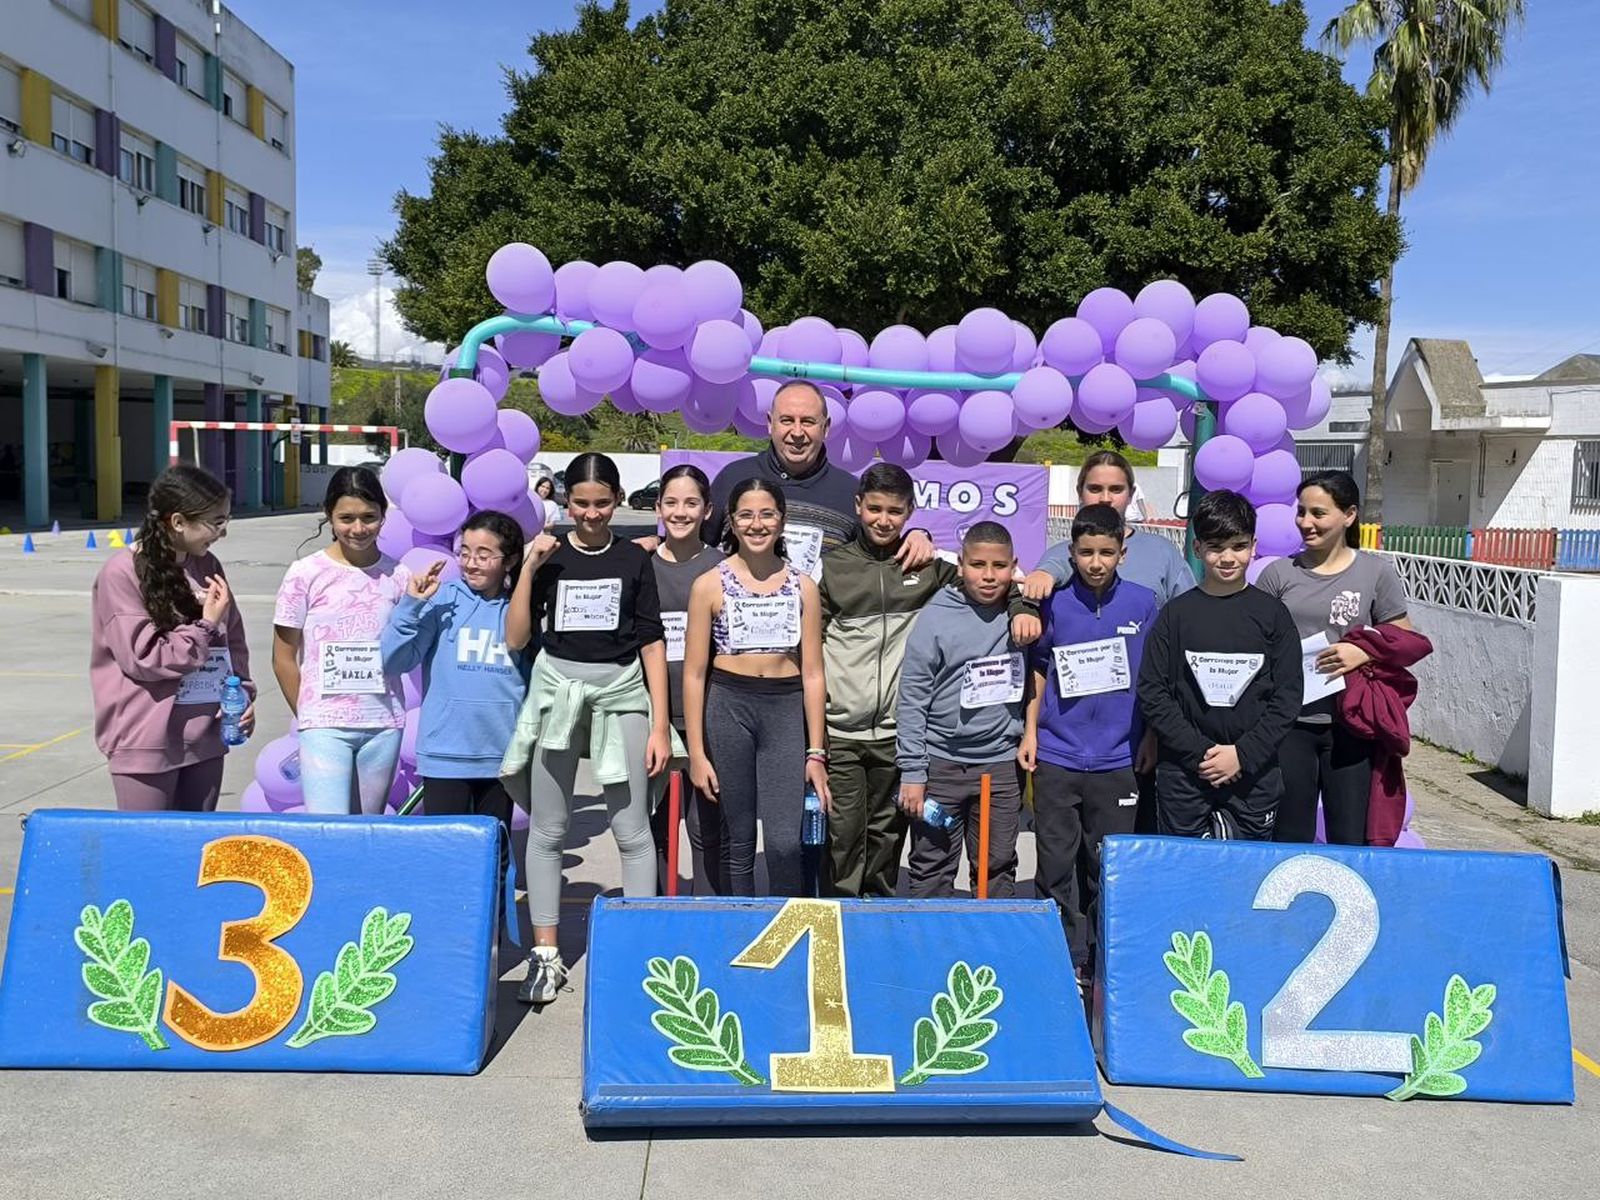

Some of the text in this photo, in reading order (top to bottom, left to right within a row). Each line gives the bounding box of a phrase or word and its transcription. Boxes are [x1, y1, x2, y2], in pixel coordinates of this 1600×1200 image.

[162, 834, 313, 1052] 3
[730, 898, 896, 1093] 1
[1252, 854, 1415, 1073] 2
